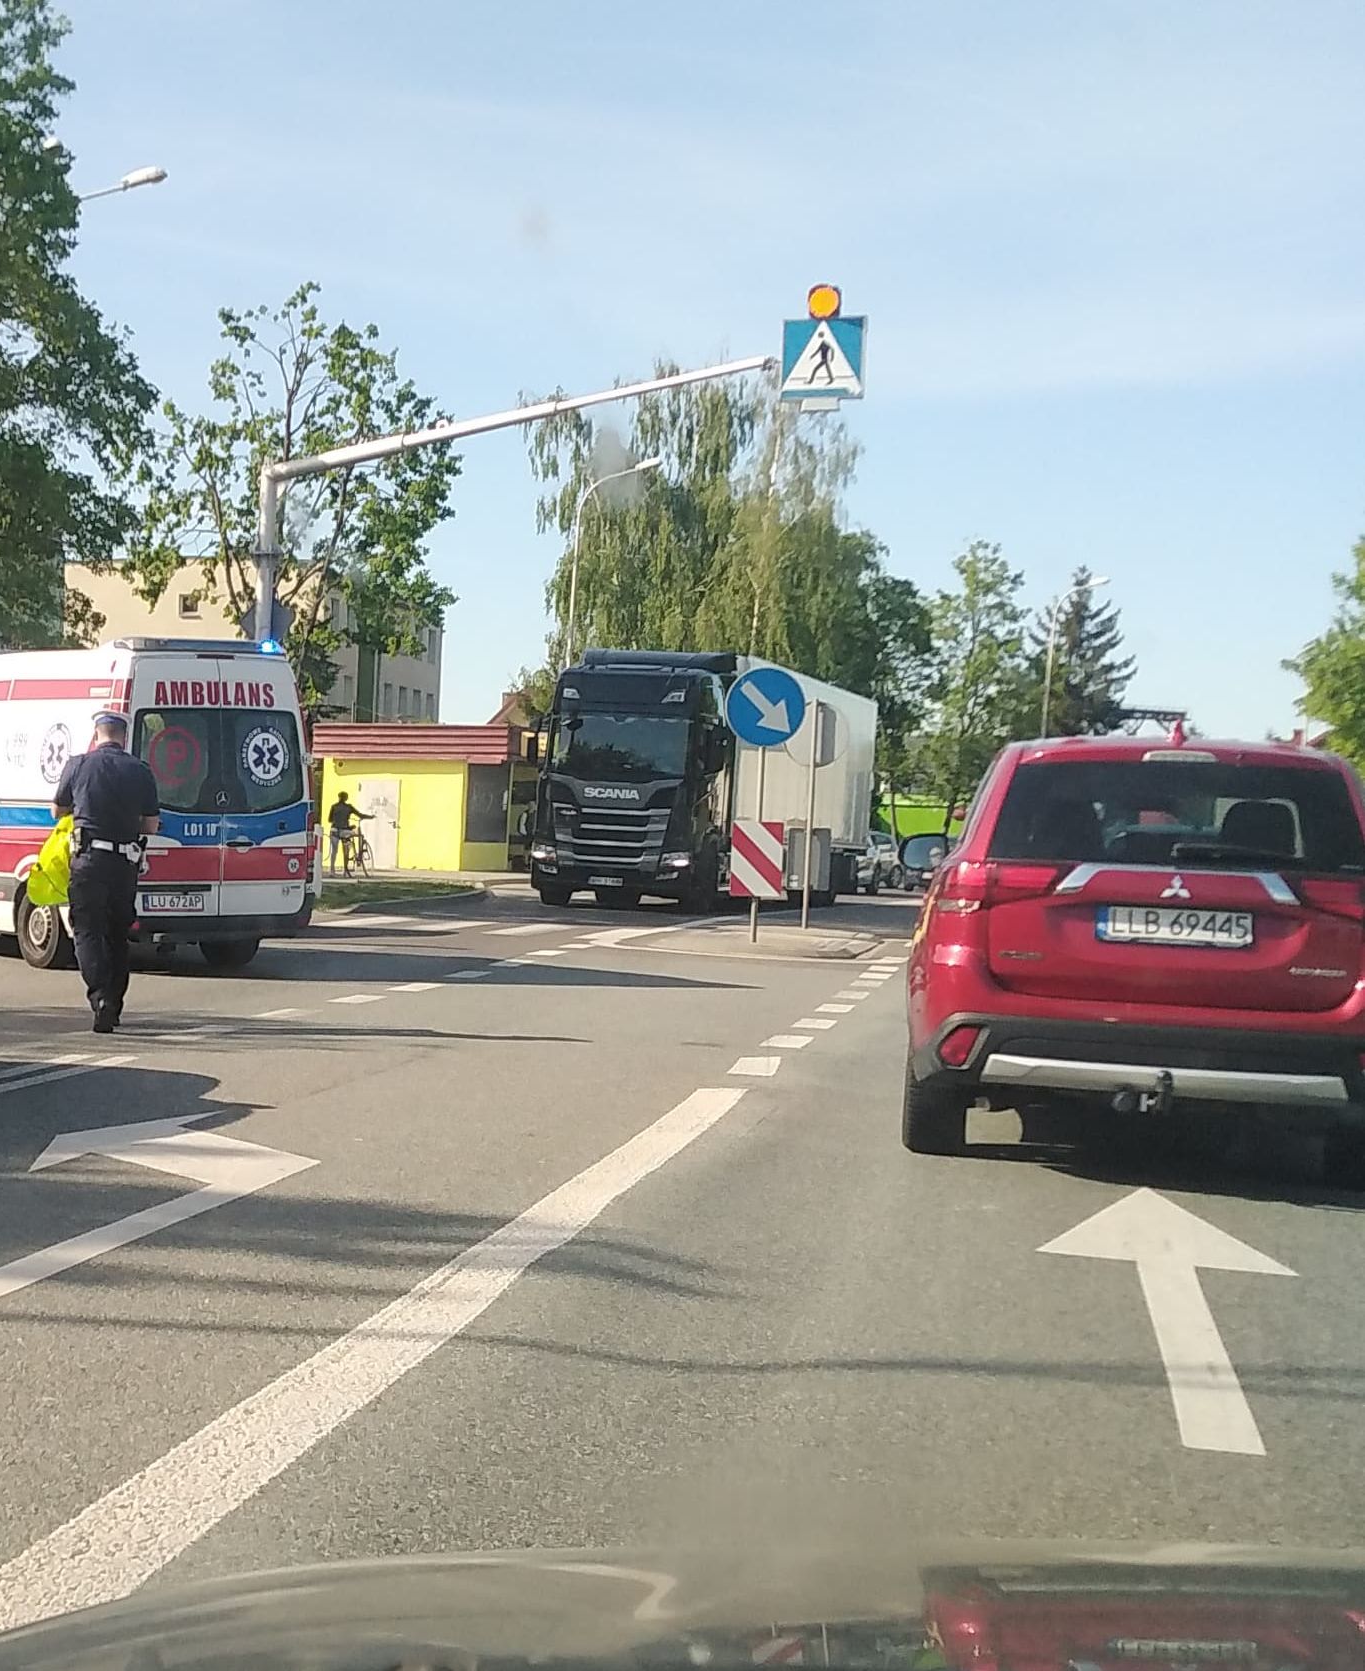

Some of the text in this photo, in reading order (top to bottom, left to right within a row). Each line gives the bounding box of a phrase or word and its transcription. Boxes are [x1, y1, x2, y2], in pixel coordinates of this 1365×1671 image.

[154, 681, 275, 708] AMBULANS
[583, 787, 640, 800] SCANIA
[151, 896, 202, 908] LU 672AP
[1111, 909, 1250, 940] LLB 69445
